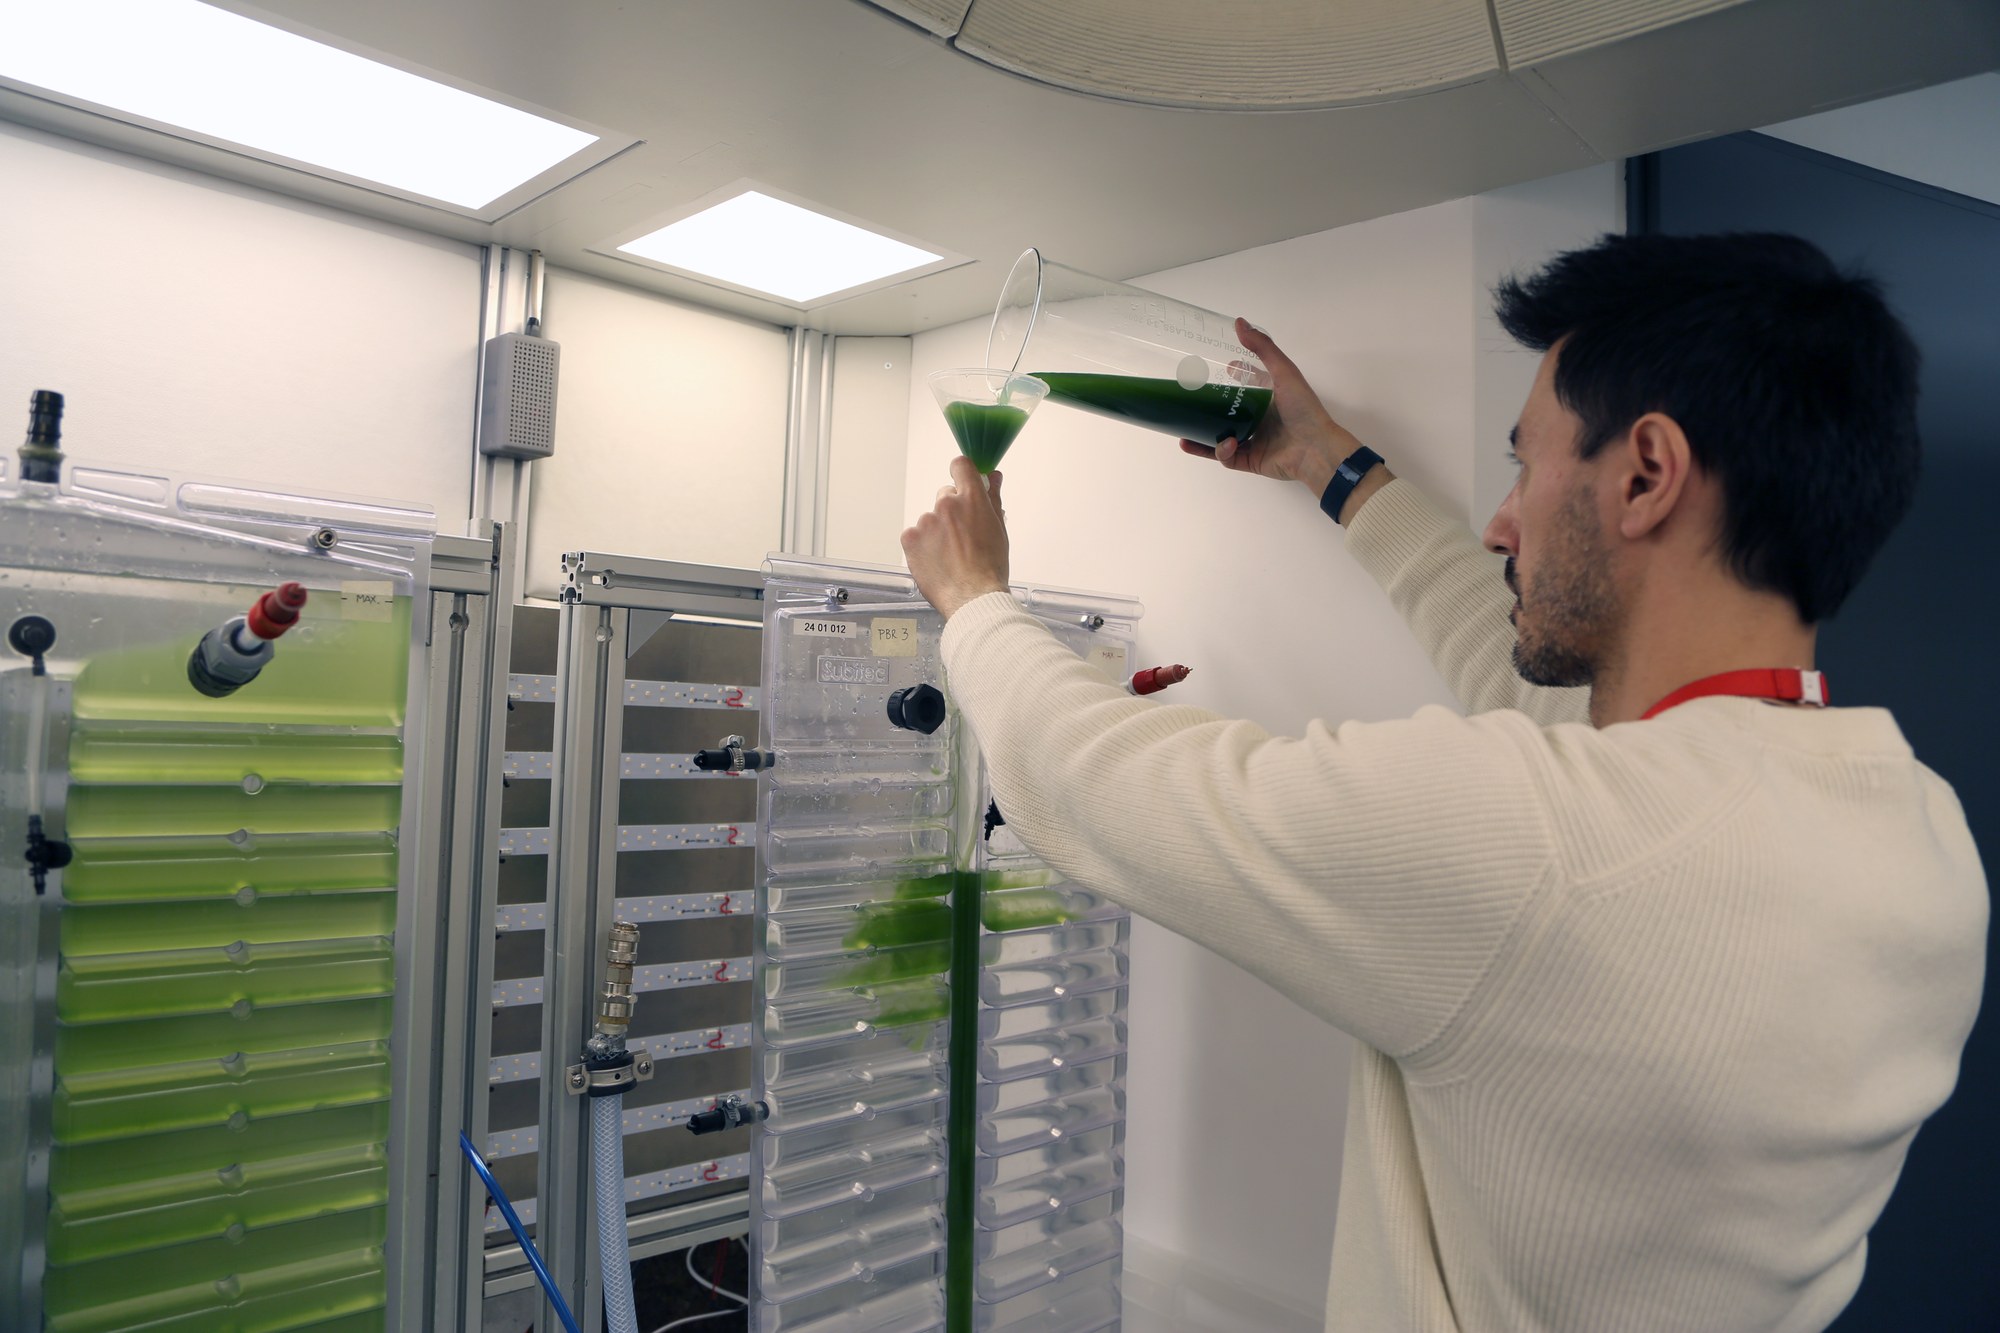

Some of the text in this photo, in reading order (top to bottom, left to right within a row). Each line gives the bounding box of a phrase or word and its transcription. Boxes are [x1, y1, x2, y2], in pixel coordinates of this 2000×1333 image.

[1163, 324, 1194, 339] GLASS
[1227, 387, 1246, 416] VWR
[804, 622, 846, 634] 24 01 012
[878, 627, 910, 641] PBR 3
[821, 660, 887, 682] Subitec
